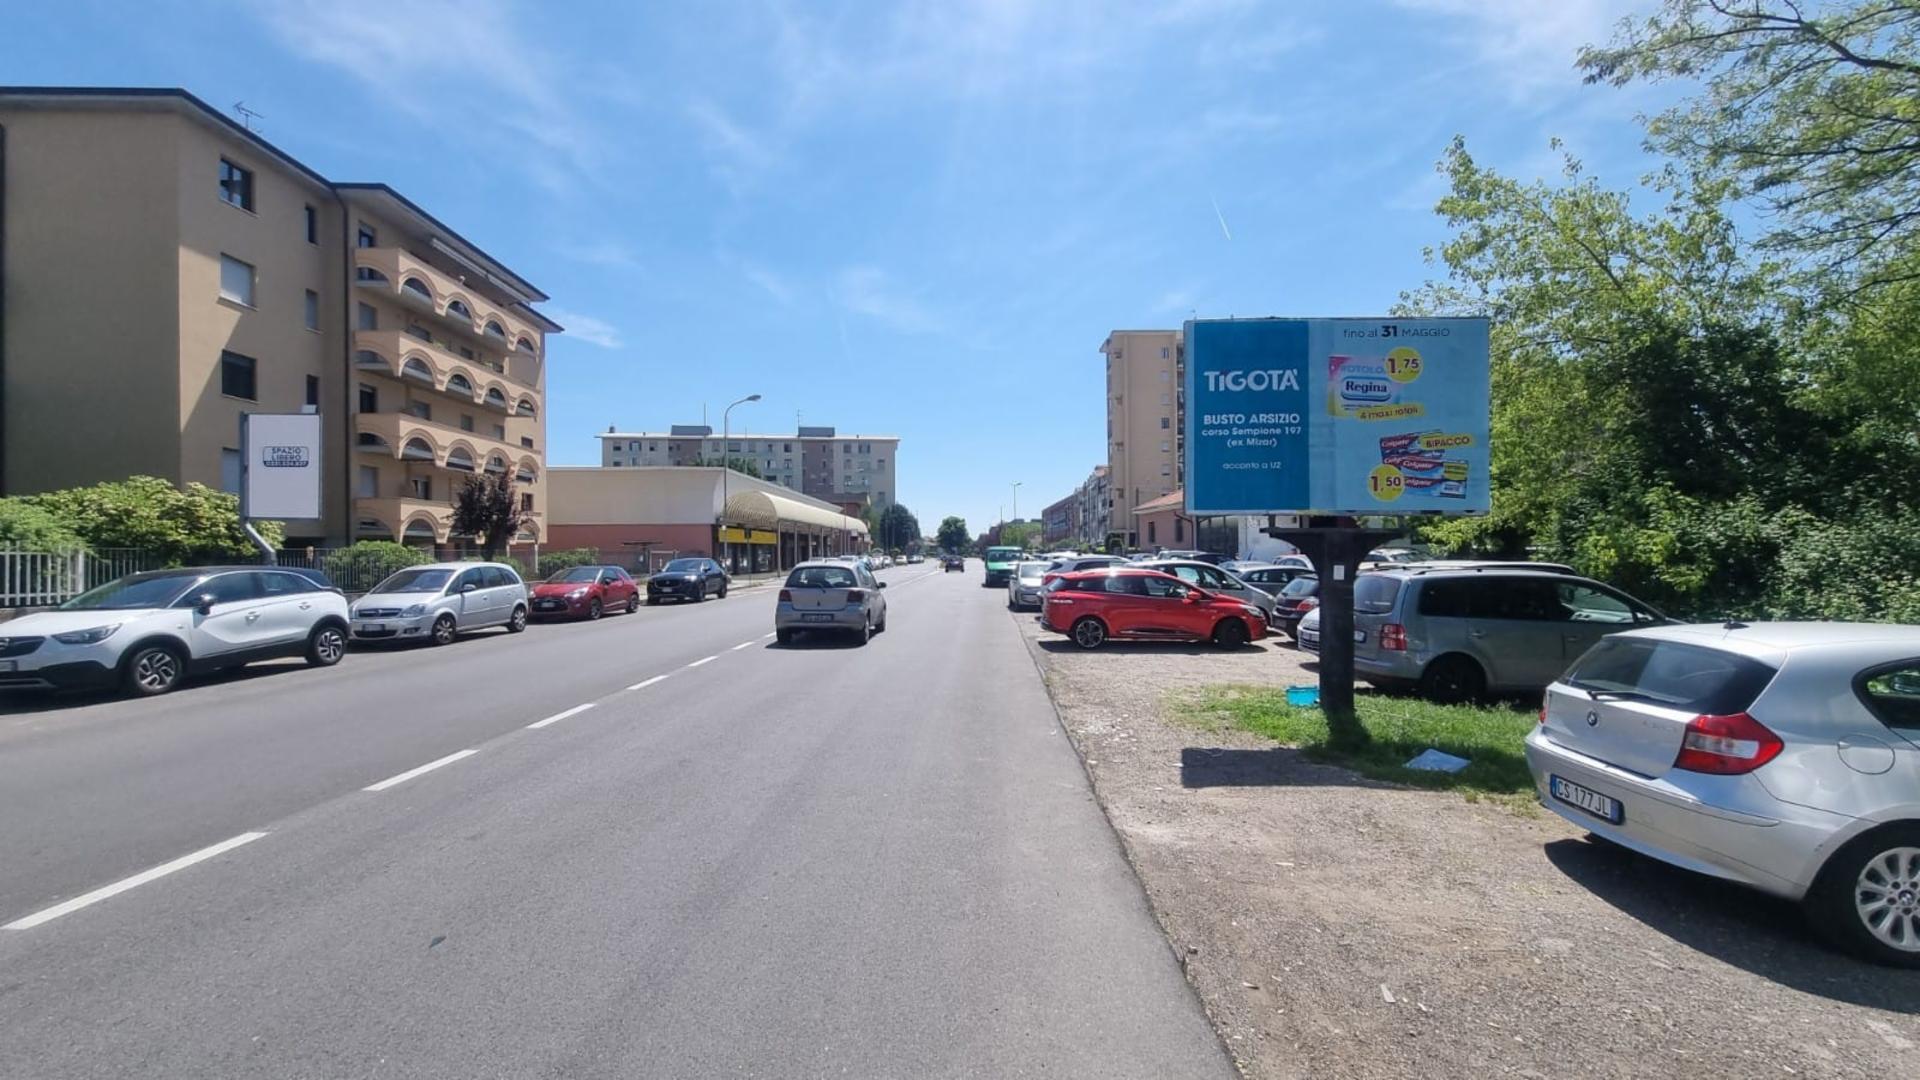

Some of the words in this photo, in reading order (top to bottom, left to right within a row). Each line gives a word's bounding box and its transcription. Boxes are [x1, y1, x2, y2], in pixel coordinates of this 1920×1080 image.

[1344, 328, 1365, 338] fino
[1368, 328, 1378, 338] al
[1381, 325, 1398, 337] 31
[1402, 327, 1450, 337] MAGGIO
[1345, 380, 1388, 394] Regina
[1203, 414, 1246, 425] BUSTO
[1249, 413, 1300, 424] ARSIZIO
[1201, 428, 1230, 436] corso
[1231, 427, 1282, 437] Sempione
[1284, 426, 1302, 435] 197
[1227, 438, 1244, 448] (ex
[1246, 437, 1278, 448] Mizar)
[1426, 436, 1470, 448] BIPACCO
[271, 446, 302, 455] SPAZIO
[1261, 462, 1268, 470] a
[1557, 780, 1571, 799] CS
[1574, 787, 1594, 808] 177
[1594, 796, 1610, 816] JL
